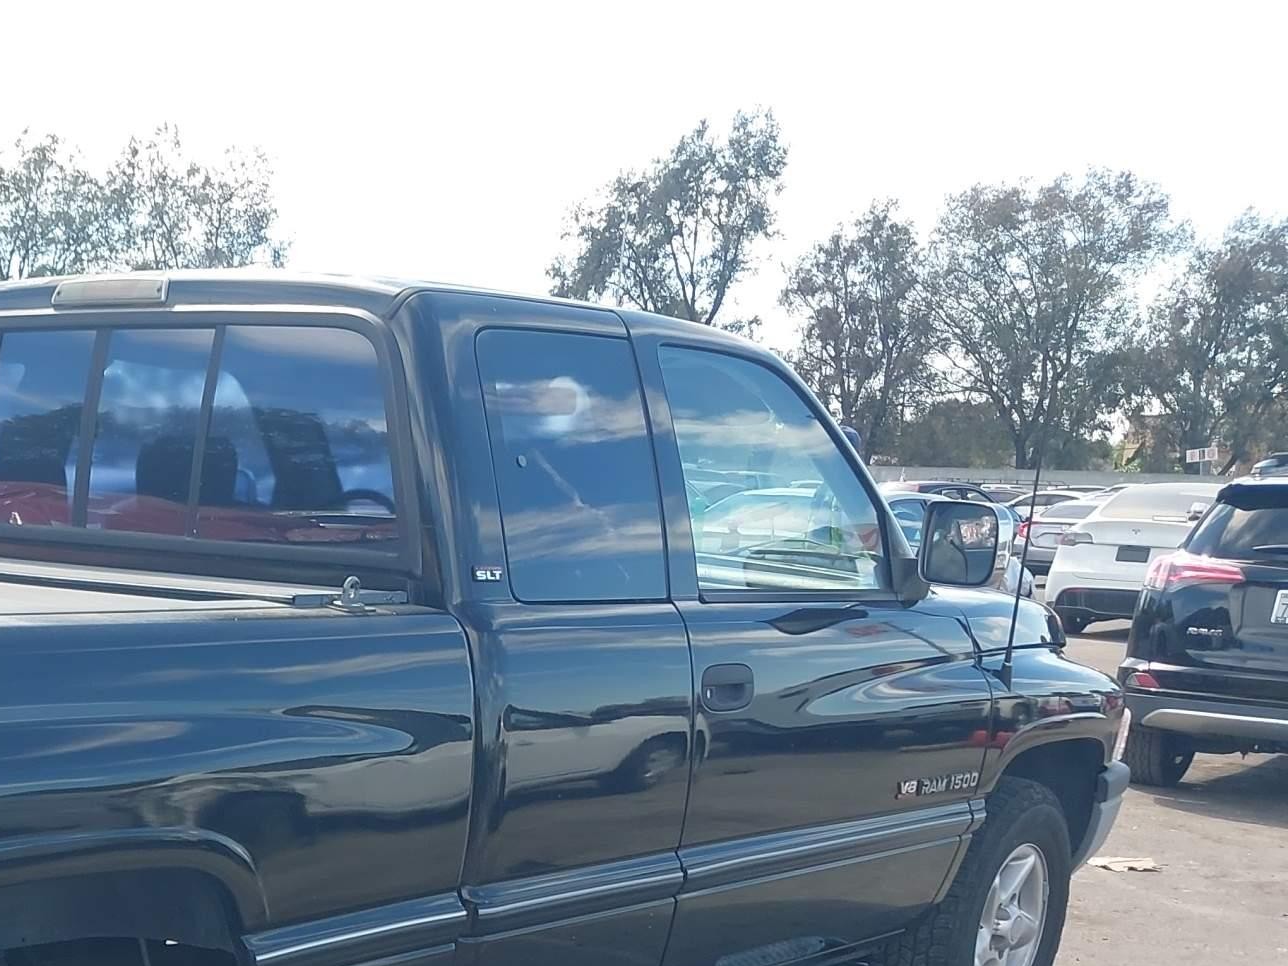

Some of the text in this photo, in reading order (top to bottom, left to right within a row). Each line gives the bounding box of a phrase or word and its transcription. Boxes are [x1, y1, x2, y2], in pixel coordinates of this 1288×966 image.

[475, 570, 502, 580] SLT
[900, 772, 979, 795] V8 RAM 1500
